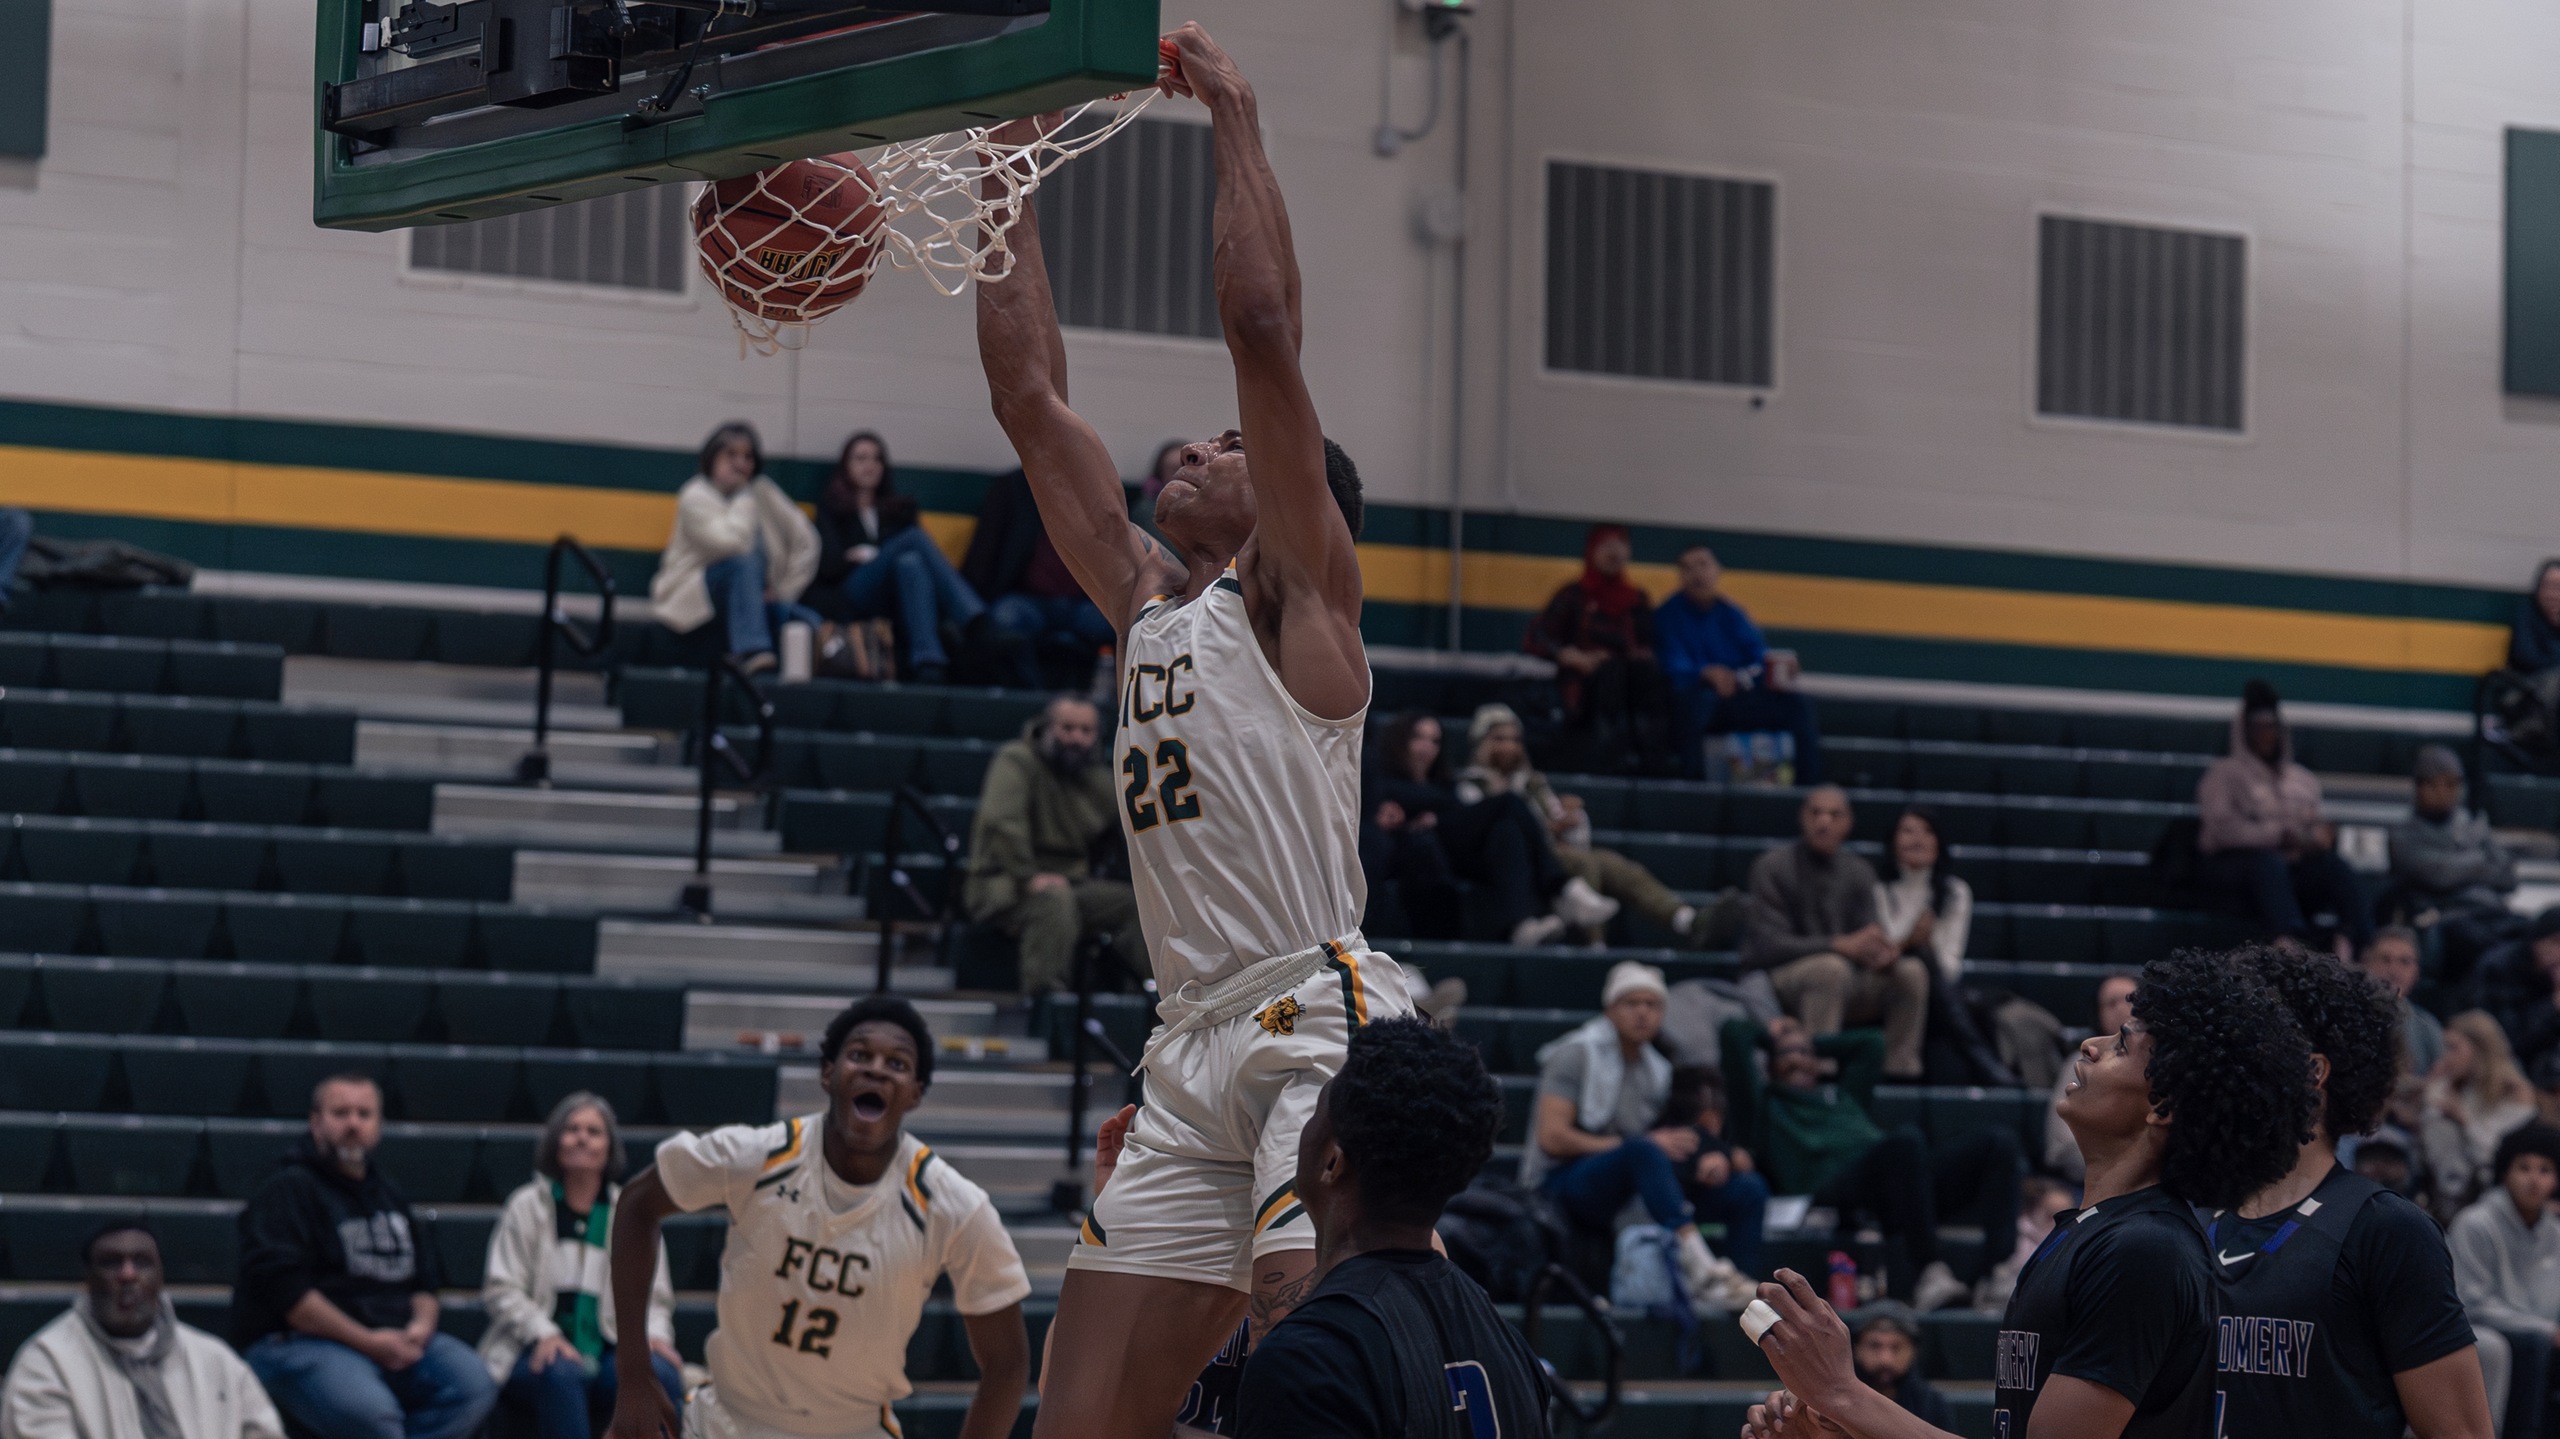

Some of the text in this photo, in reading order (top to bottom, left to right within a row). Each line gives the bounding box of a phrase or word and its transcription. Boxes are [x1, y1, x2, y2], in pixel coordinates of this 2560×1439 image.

[1122, 735, 1203, 834] 22
[775, 1237, 870, 1297] FCC
[772, 1300, 840, 1360] 12
